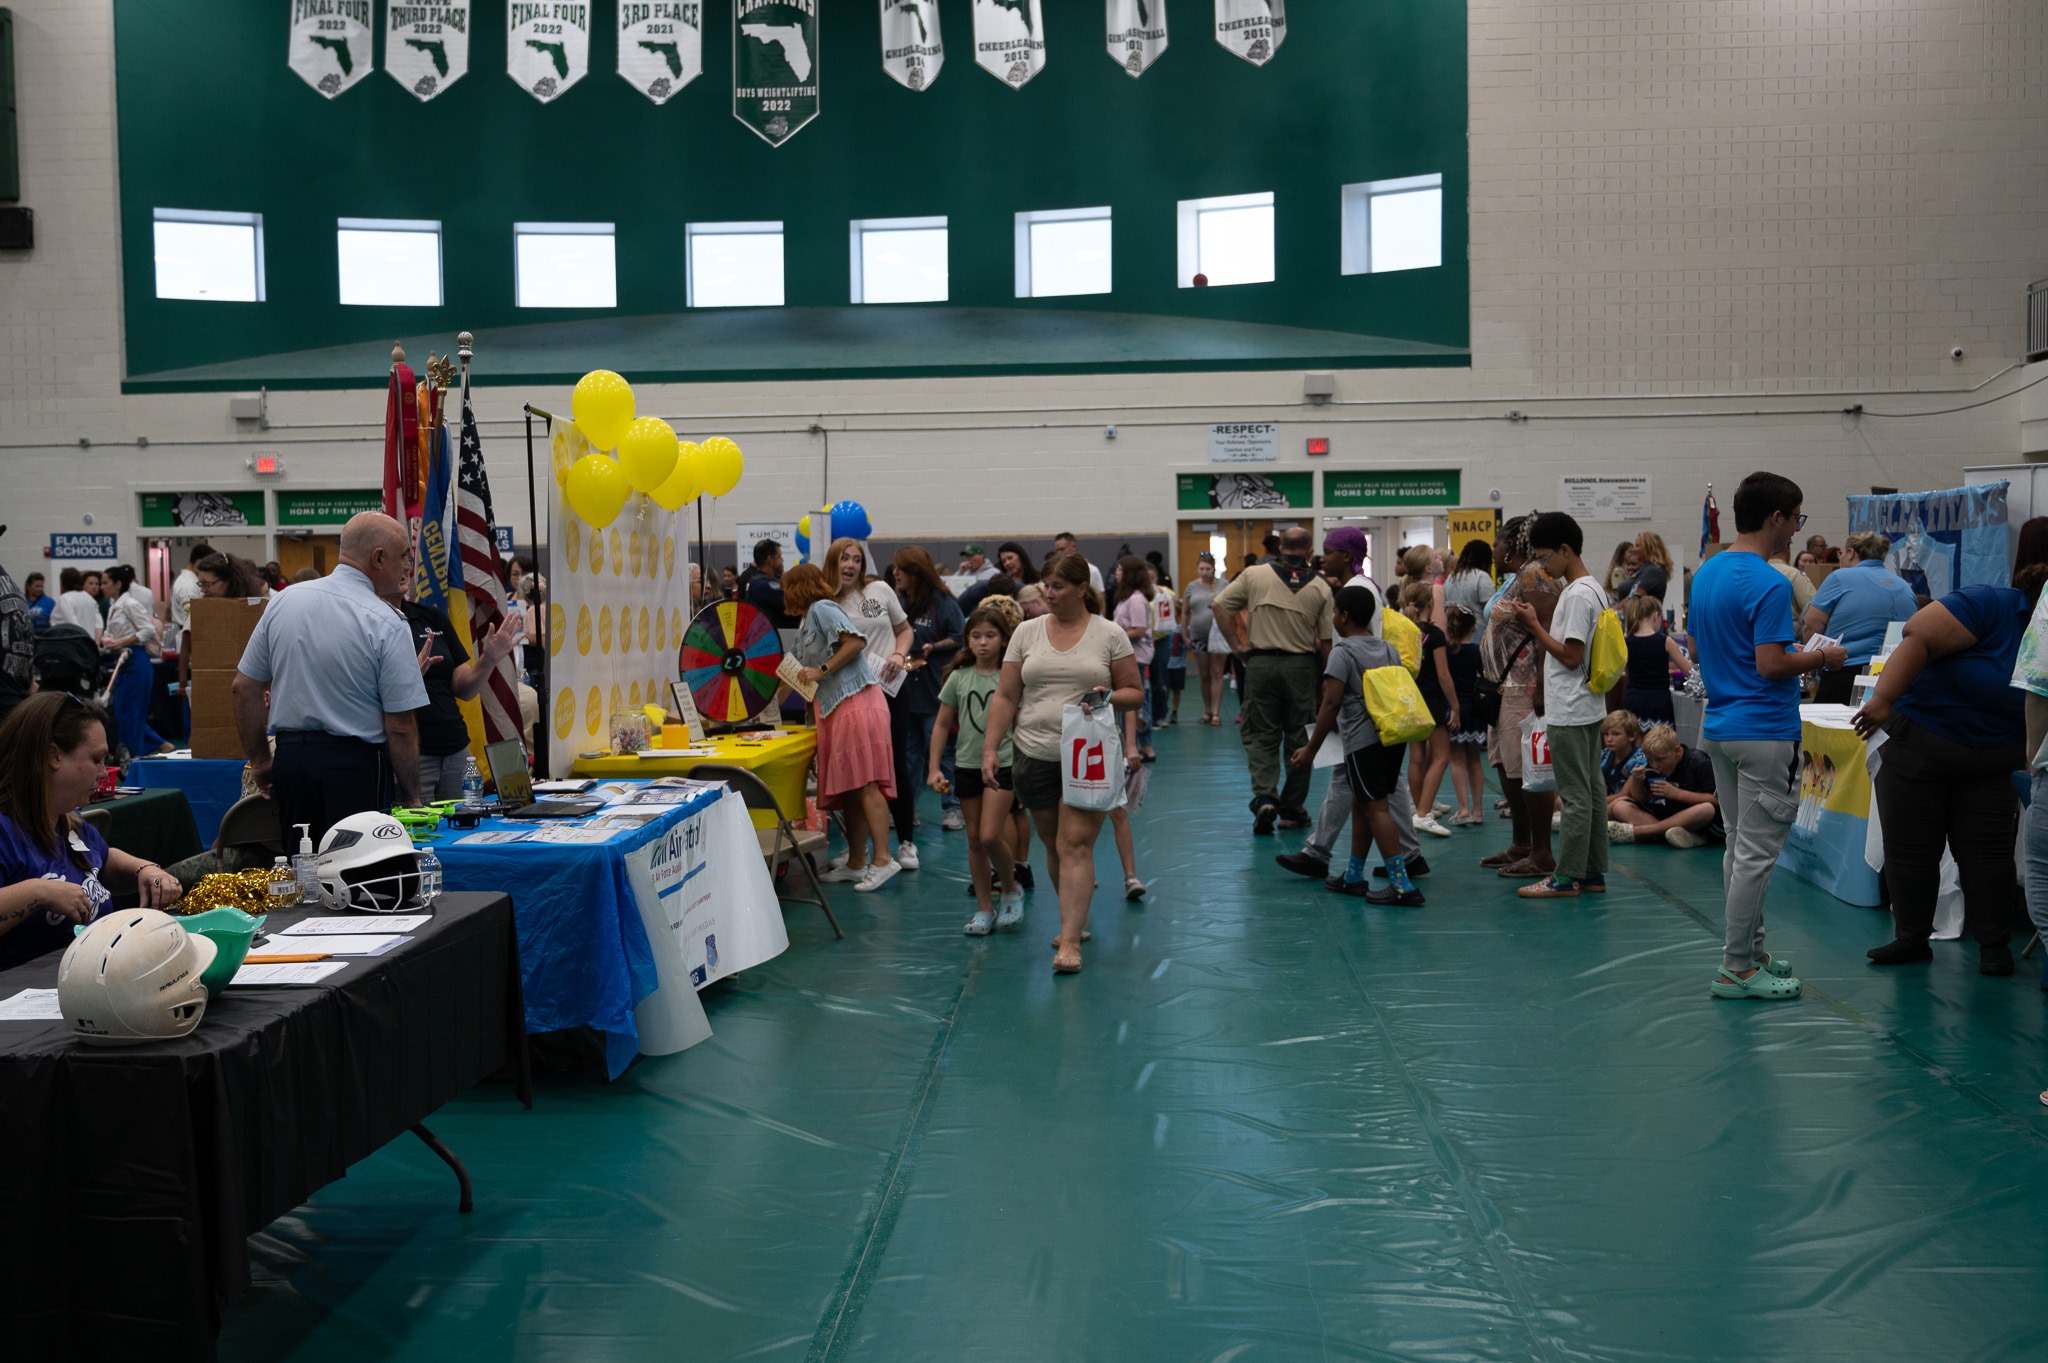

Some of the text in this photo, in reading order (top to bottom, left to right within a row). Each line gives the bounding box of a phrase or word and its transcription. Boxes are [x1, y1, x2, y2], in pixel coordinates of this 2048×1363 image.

[294, 0, 370, 30] FINAL FOUR
[391, 6, 466, 34] THIRD PLACE
[511, 3, 586, 33] FINAL FOUR
[622, 4, 698, 32] 3RD PLACE
[318, 20, 346, 30] 2022
[413, 23, 442, 34] 2022
[533, 24, 562, 34] 2022
[647, 24, 674, 34] 2021
[1243, 27, 1271, 40] 2016
[1004, 50, 1029, 63] 2015
[736, 86, 816, 98] BOYS WEIGHTLIFTING
[762, 100, 791, 111] 2022
[1334, 489, 1361, 497] HOME
[1364, 489, 1377, 497] OF
[1399, 488, 1447, 496] BULLDOGS
[332, 507, 348, 515] THE
[1453, 520, 1492, 532] NAACP
[56, 536, 112, 546] FLAGLER
[55, 546, 114, 557] SCHOOLS
[669, 829, 682, 861] Air
[159, 970, 189, 992] RAWLINGS
